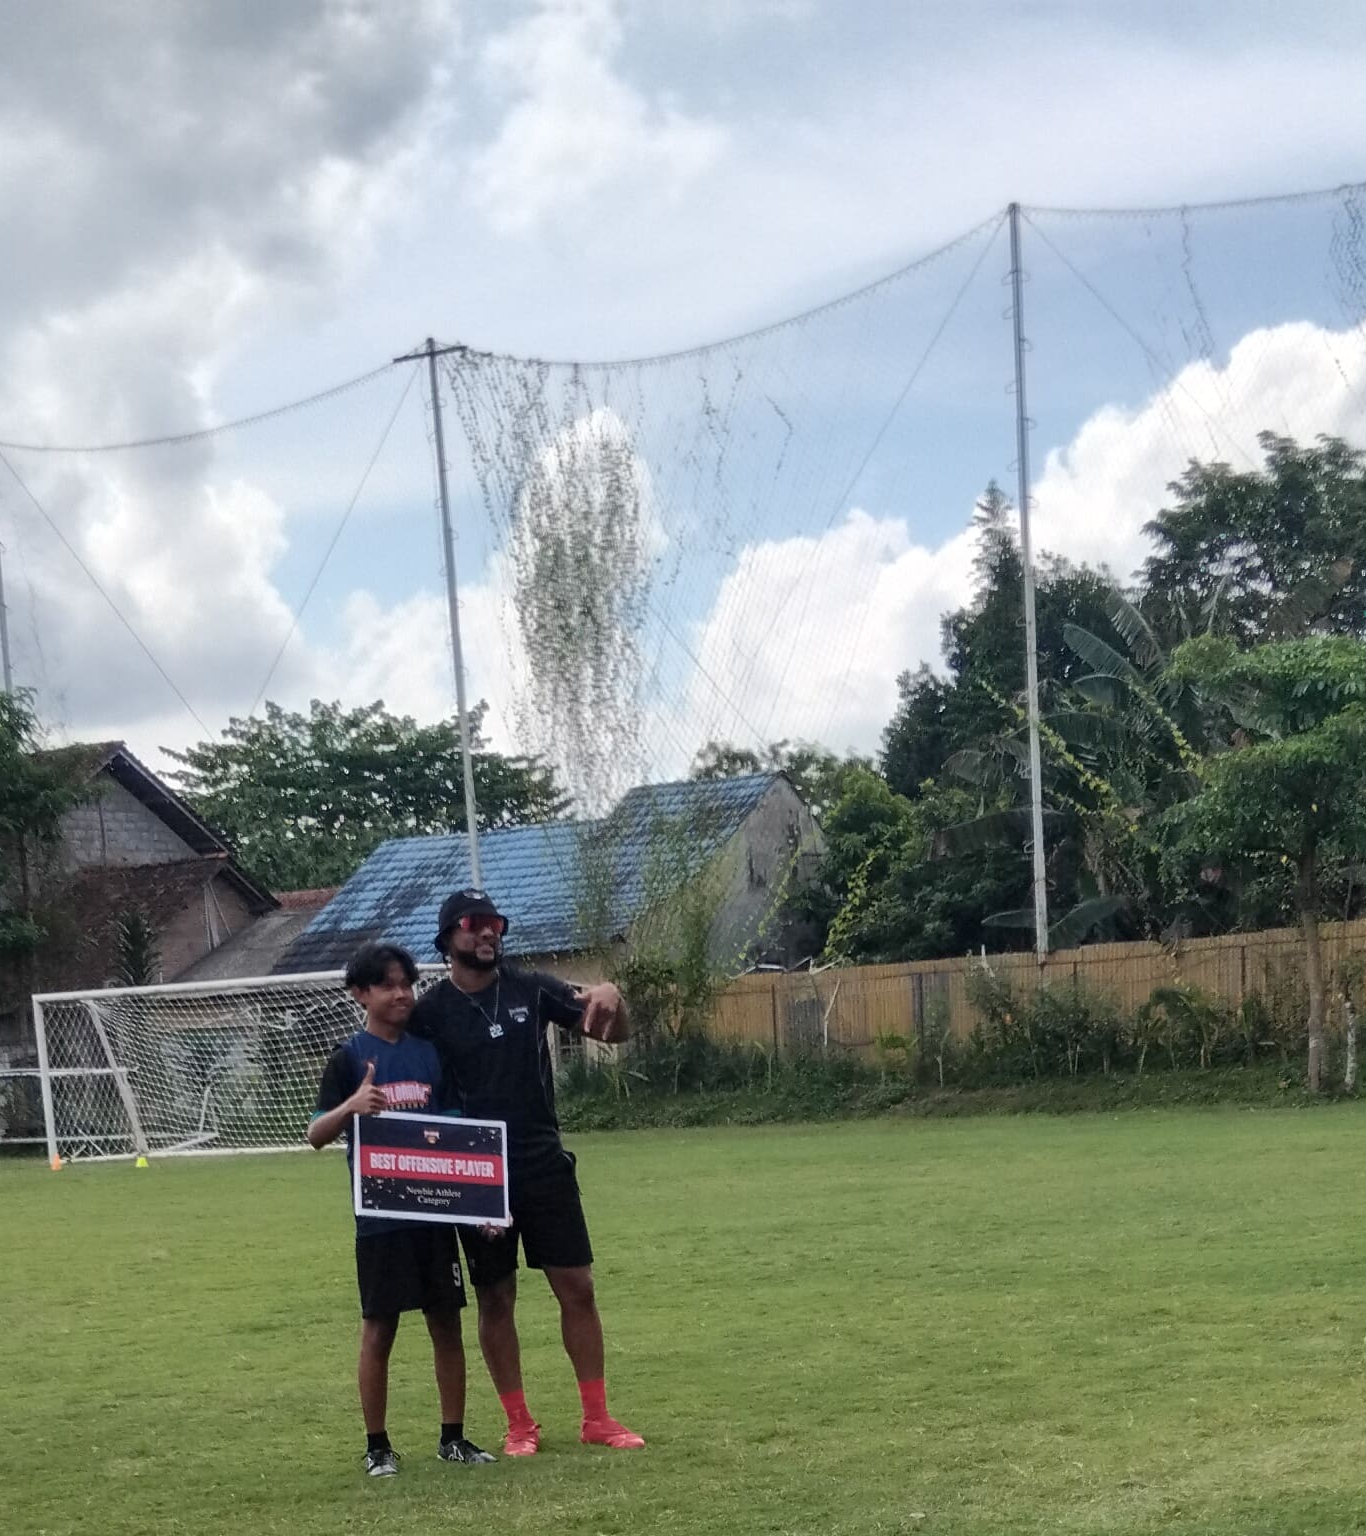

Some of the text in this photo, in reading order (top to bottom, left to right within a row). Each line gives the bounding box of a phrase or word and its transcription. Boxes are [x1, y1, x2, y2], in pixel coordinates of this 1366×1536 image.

[370, 1153, 494, 1178] BEST OFFENSIVE PLAYER
[406, 1186, 461, 1198] Newbie Athlete
[417, 1196, 451, 1207] Category
